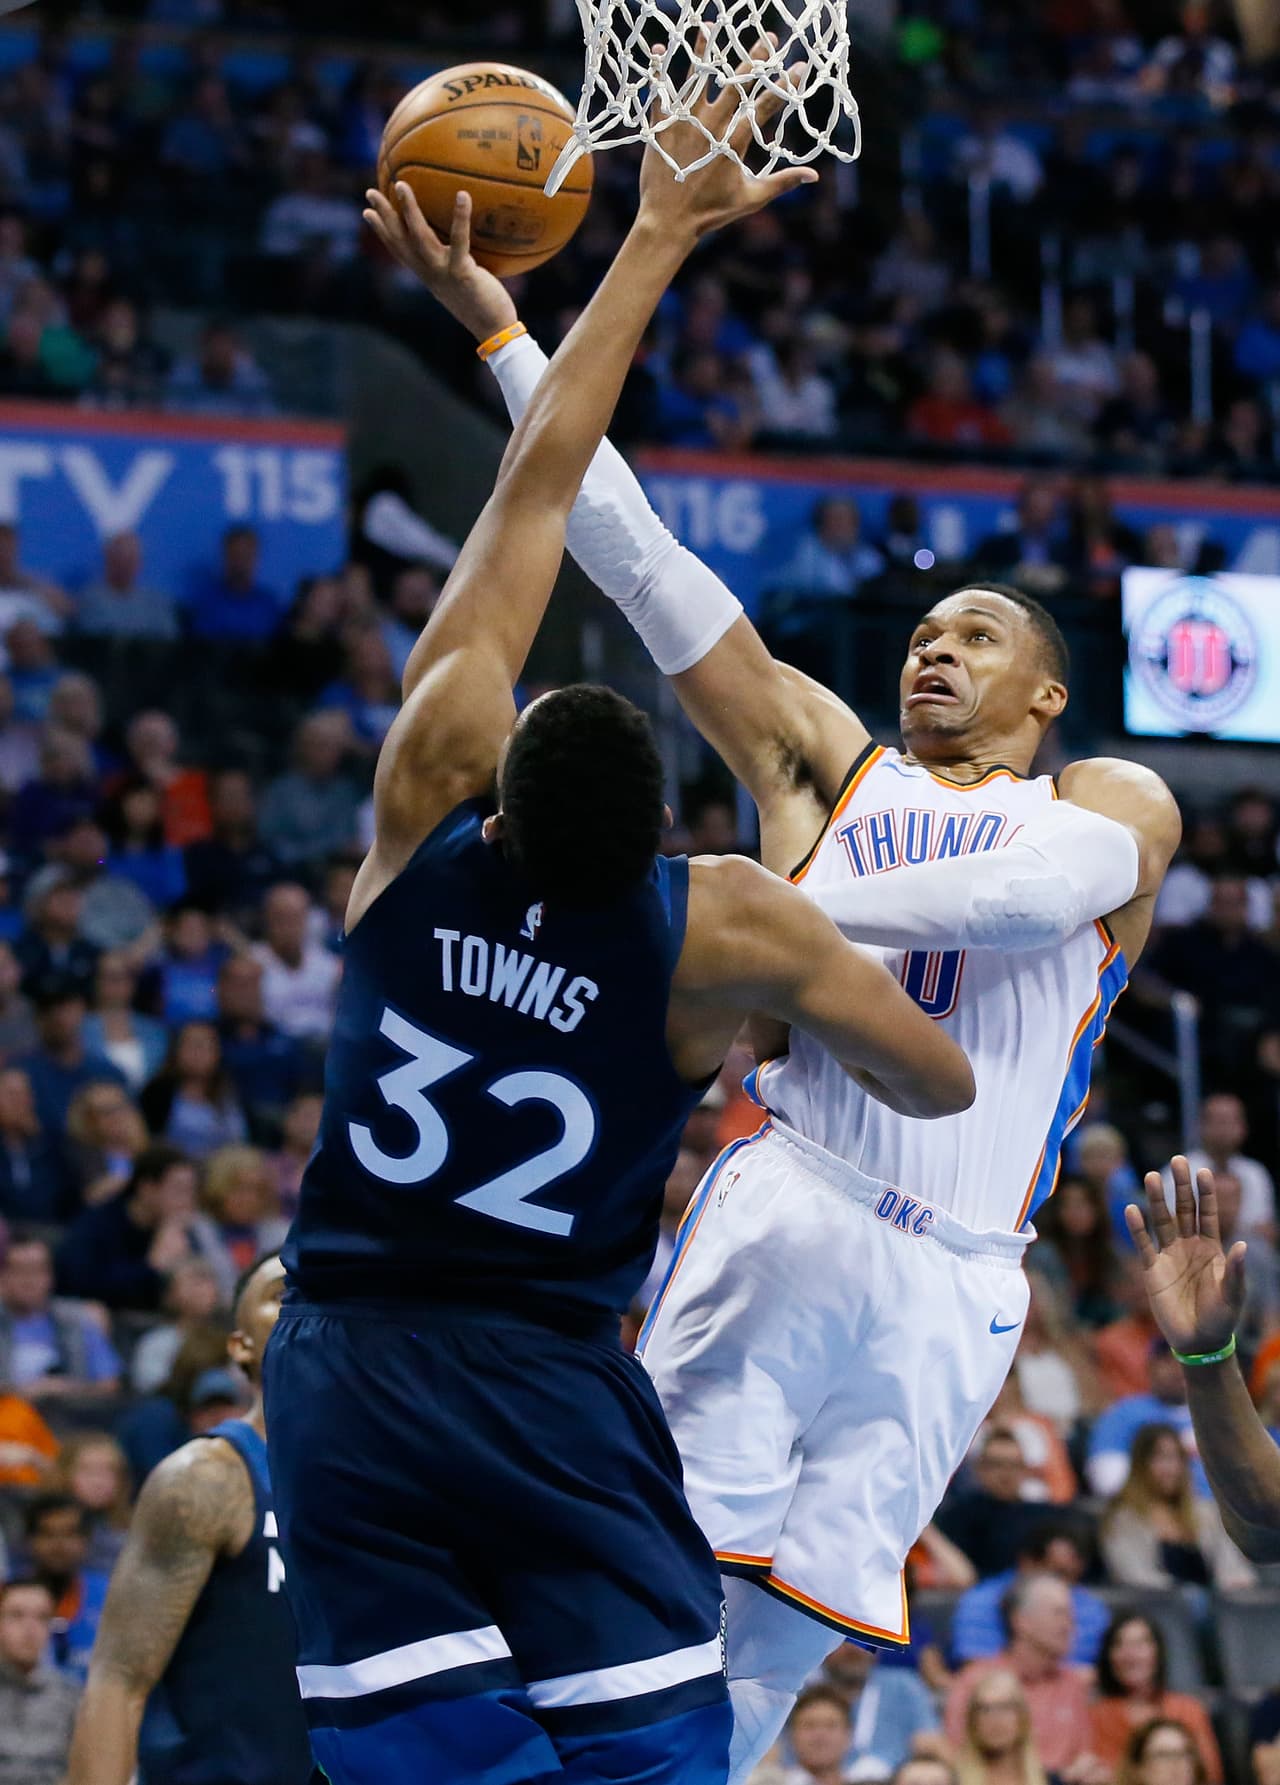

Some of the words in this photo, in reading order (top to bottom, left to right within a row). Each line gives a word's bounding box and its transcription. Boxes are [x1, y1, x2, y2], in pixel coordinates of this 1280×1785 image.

[214, 446, 340, 522] 115
[835, 807, 1025, 877] THUND
[434, 928, 600, 1033] TOWNS
[348, 1006, 596, 1237] 32
[874, 1188, 935, 1238] OKC
